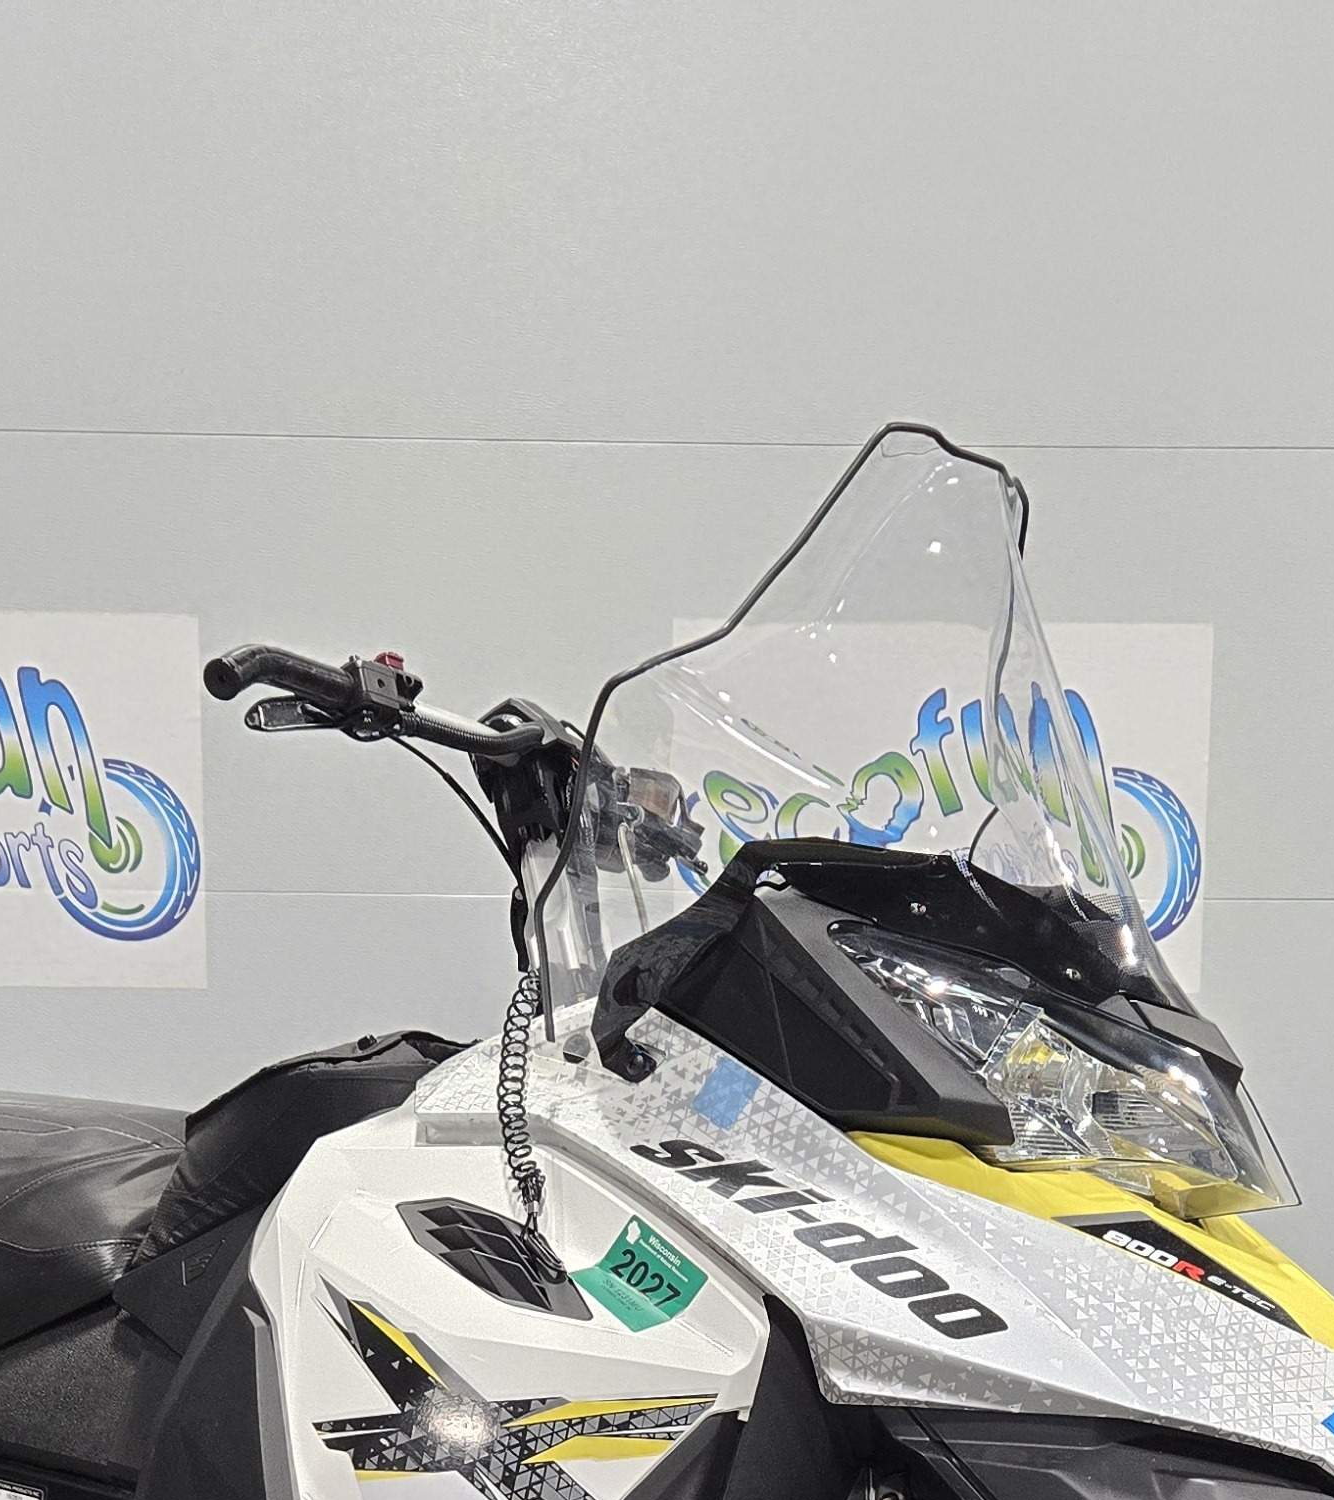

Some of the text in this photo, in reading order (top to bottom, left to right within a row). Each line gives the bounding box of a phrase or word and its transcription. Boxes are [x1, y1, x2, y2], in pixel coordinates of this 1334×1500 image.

[629, 1139, 1010, 1340] ski-doo
[648, 1234, 682, 1267] Wisconsin
[1102, 1229, 1205, 1282] 800R
[609, 1248, 682, 1307] 2027
